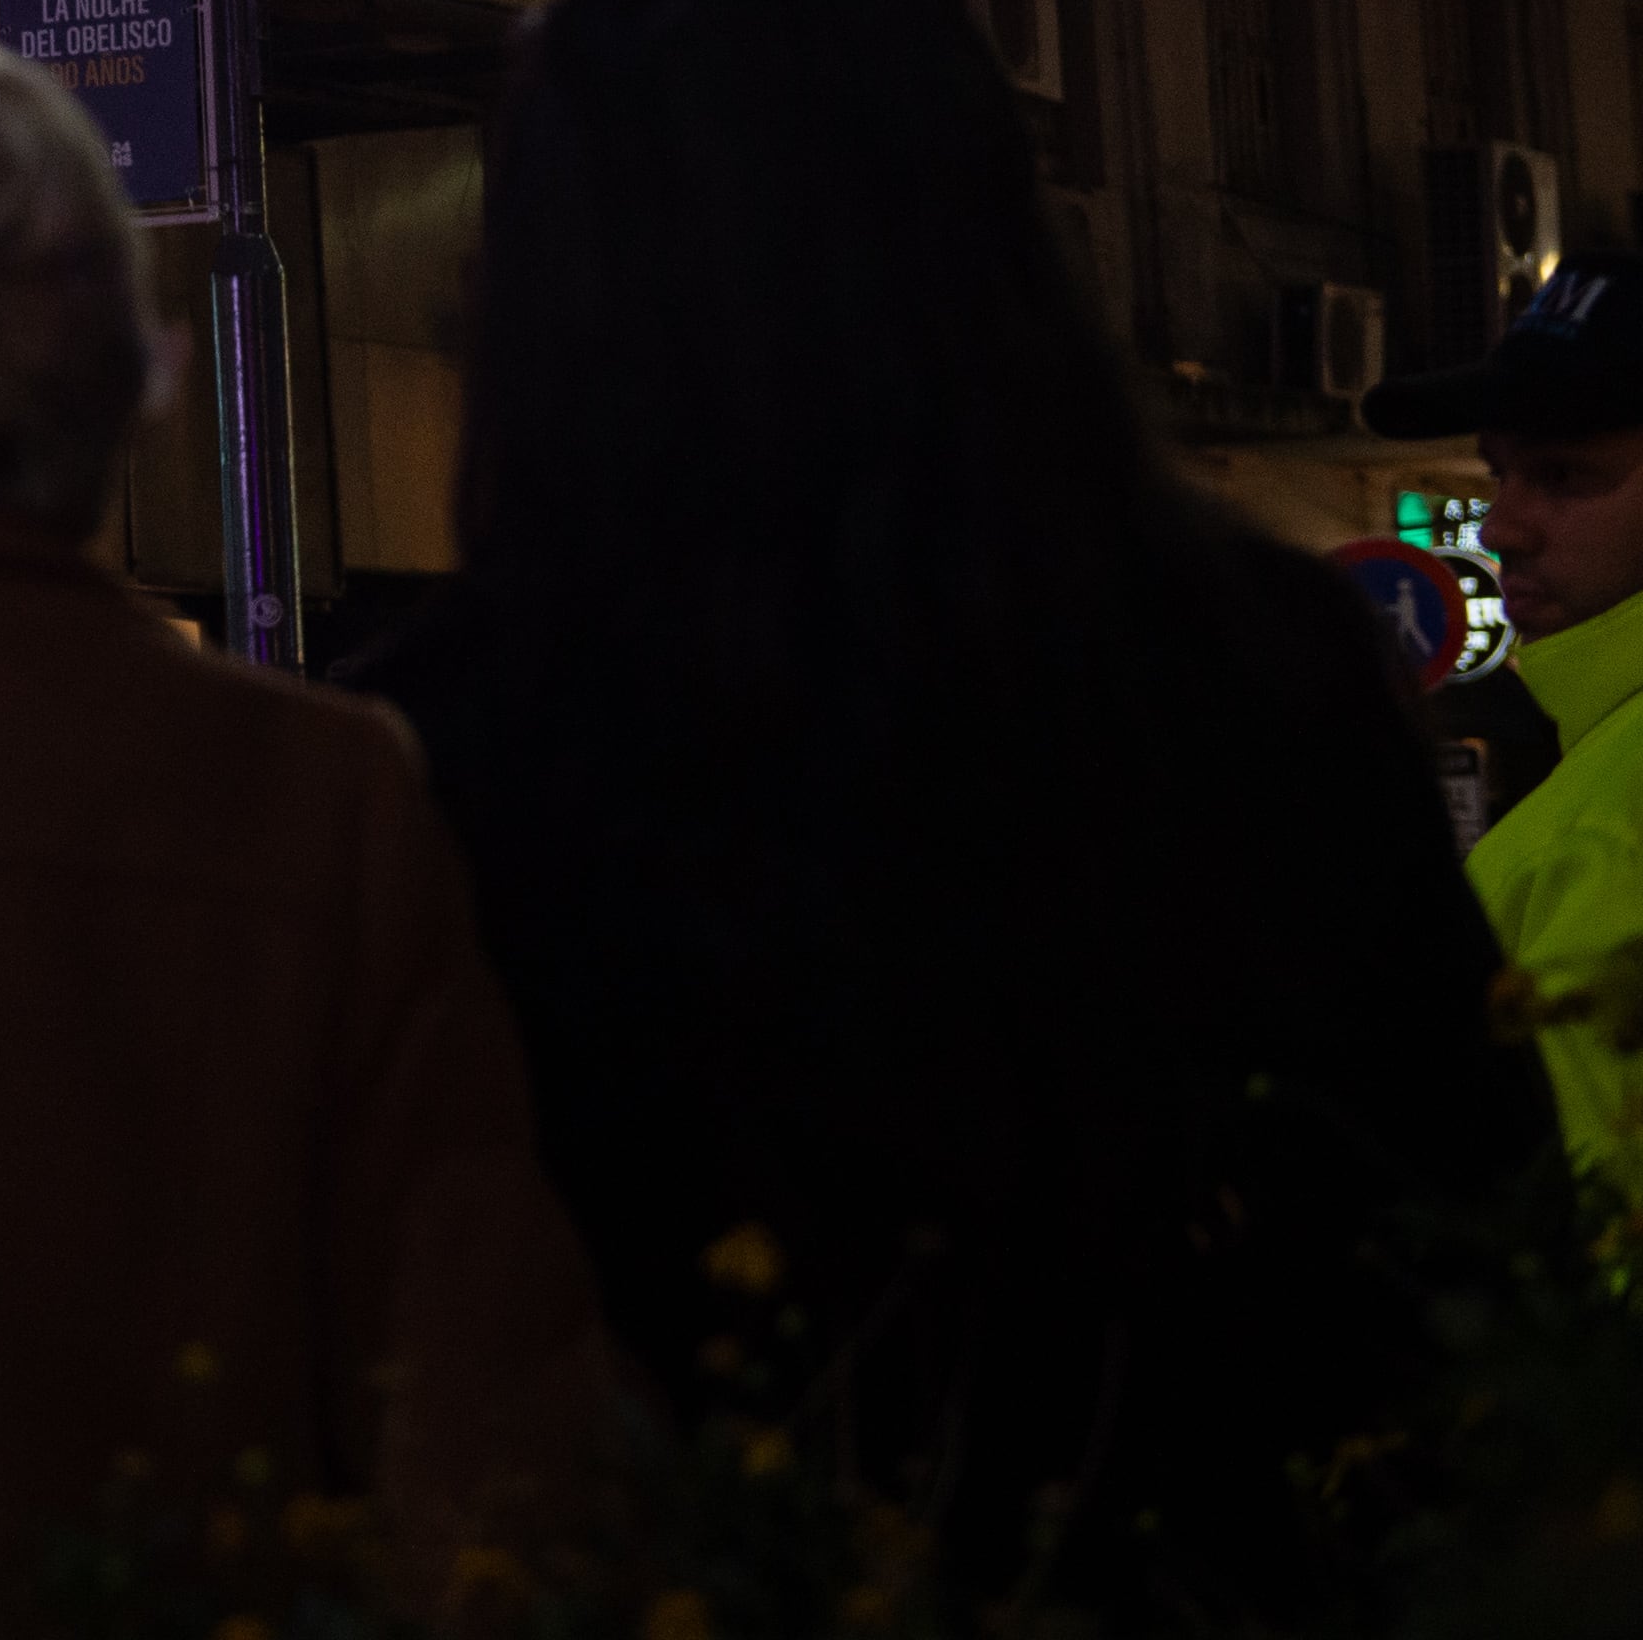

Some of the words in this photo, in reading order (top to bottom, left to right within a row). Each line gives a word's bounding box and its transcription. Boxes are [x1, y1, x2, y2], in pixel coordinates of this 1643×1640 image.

[21, 28, 62, 58] DEL
[66, 18, 172, 55] OBELISCO
[85, 52, 146, 88] AÑOS
